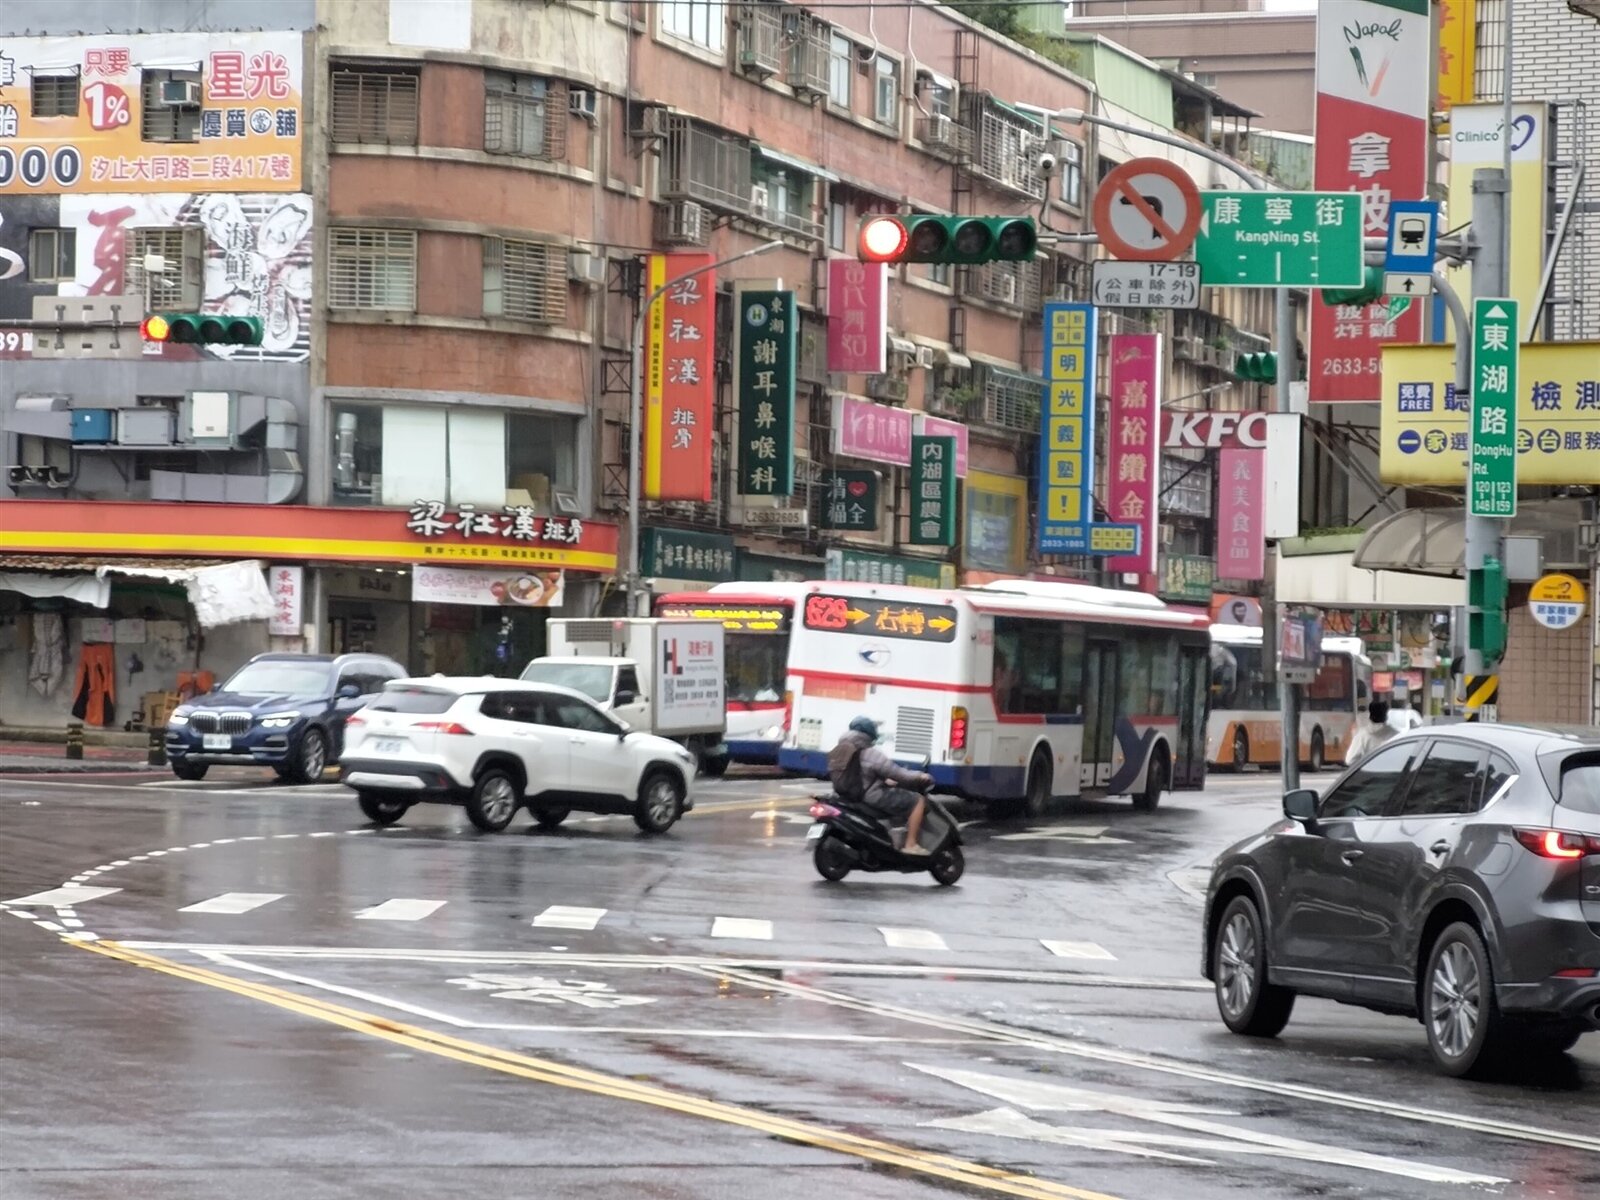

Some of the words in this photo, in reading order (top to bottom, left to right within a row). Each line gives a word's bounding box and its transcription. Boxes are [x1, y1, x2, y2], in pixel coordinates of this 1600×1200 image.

[84, 47, 131, 77] 只要
[208, 50, 290, 100] 星光
[85, 83, 130, 127] 1%
[1455, 130, 1499, 143] Clinico
[91, 154, 292, 181] 汐止大同路二段417號
[1212, 197, 1344, 227] 康寧街
[225, 222, 252, 282] 海鮮
[1235, 230, 1299, 246] KangNing
[1303, 230, 1321, 244] St.
[1149, 264, 1197, 278] 17-19
[769, 296, 786, 334] 東湖
[668, 277, 702, 449] 梁社漢排骨
[1480, 324, 1510, 436] 東湖路
[1400, 385, 1431, 399] 免費
[1401, 400, 1431, 410] FREE
[751, 339, 779, 493] 謝耳鼻喉科
[1164, 412, 1267, 448] KFC
[1119, 379, 1148, 519] 嘉裕鑽金
[1473, 443, 1513, 459] DongHu
[1473, 463, 1490, 475] Rd.
[920, 443, 943, 539] 內湖區農會
[1230, 459, 1251, 559] 義美食品
